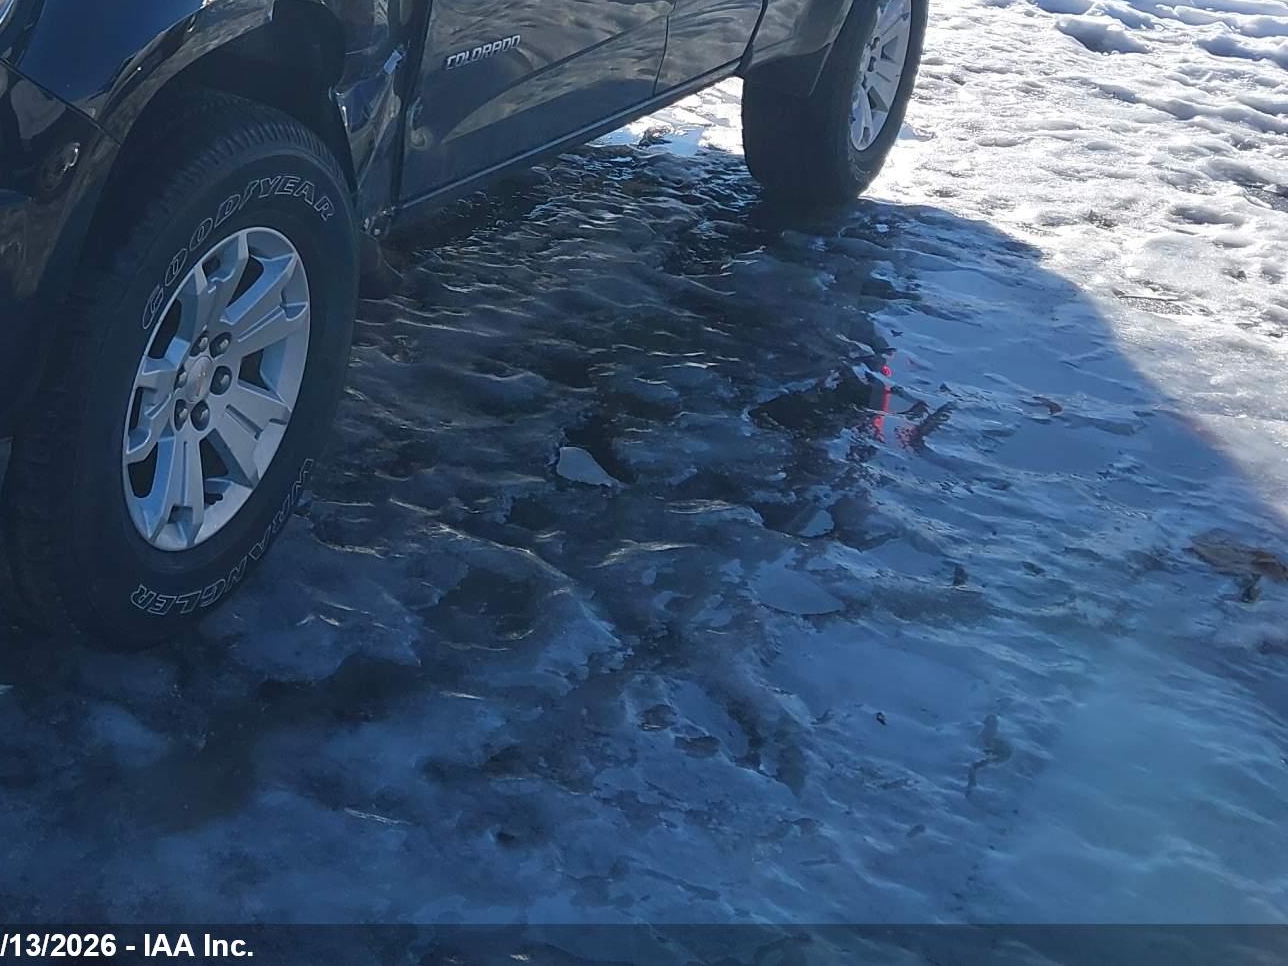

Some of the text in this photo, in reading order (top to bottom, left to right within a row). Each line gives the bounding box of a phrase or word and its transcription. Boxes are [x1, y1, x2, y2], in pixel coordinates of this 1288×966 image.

[447, 34, 521, 70] COLORADO
[142, 175, 335, 329] GOODYEAR
[130, 458, 314, 615] WRANGLER
